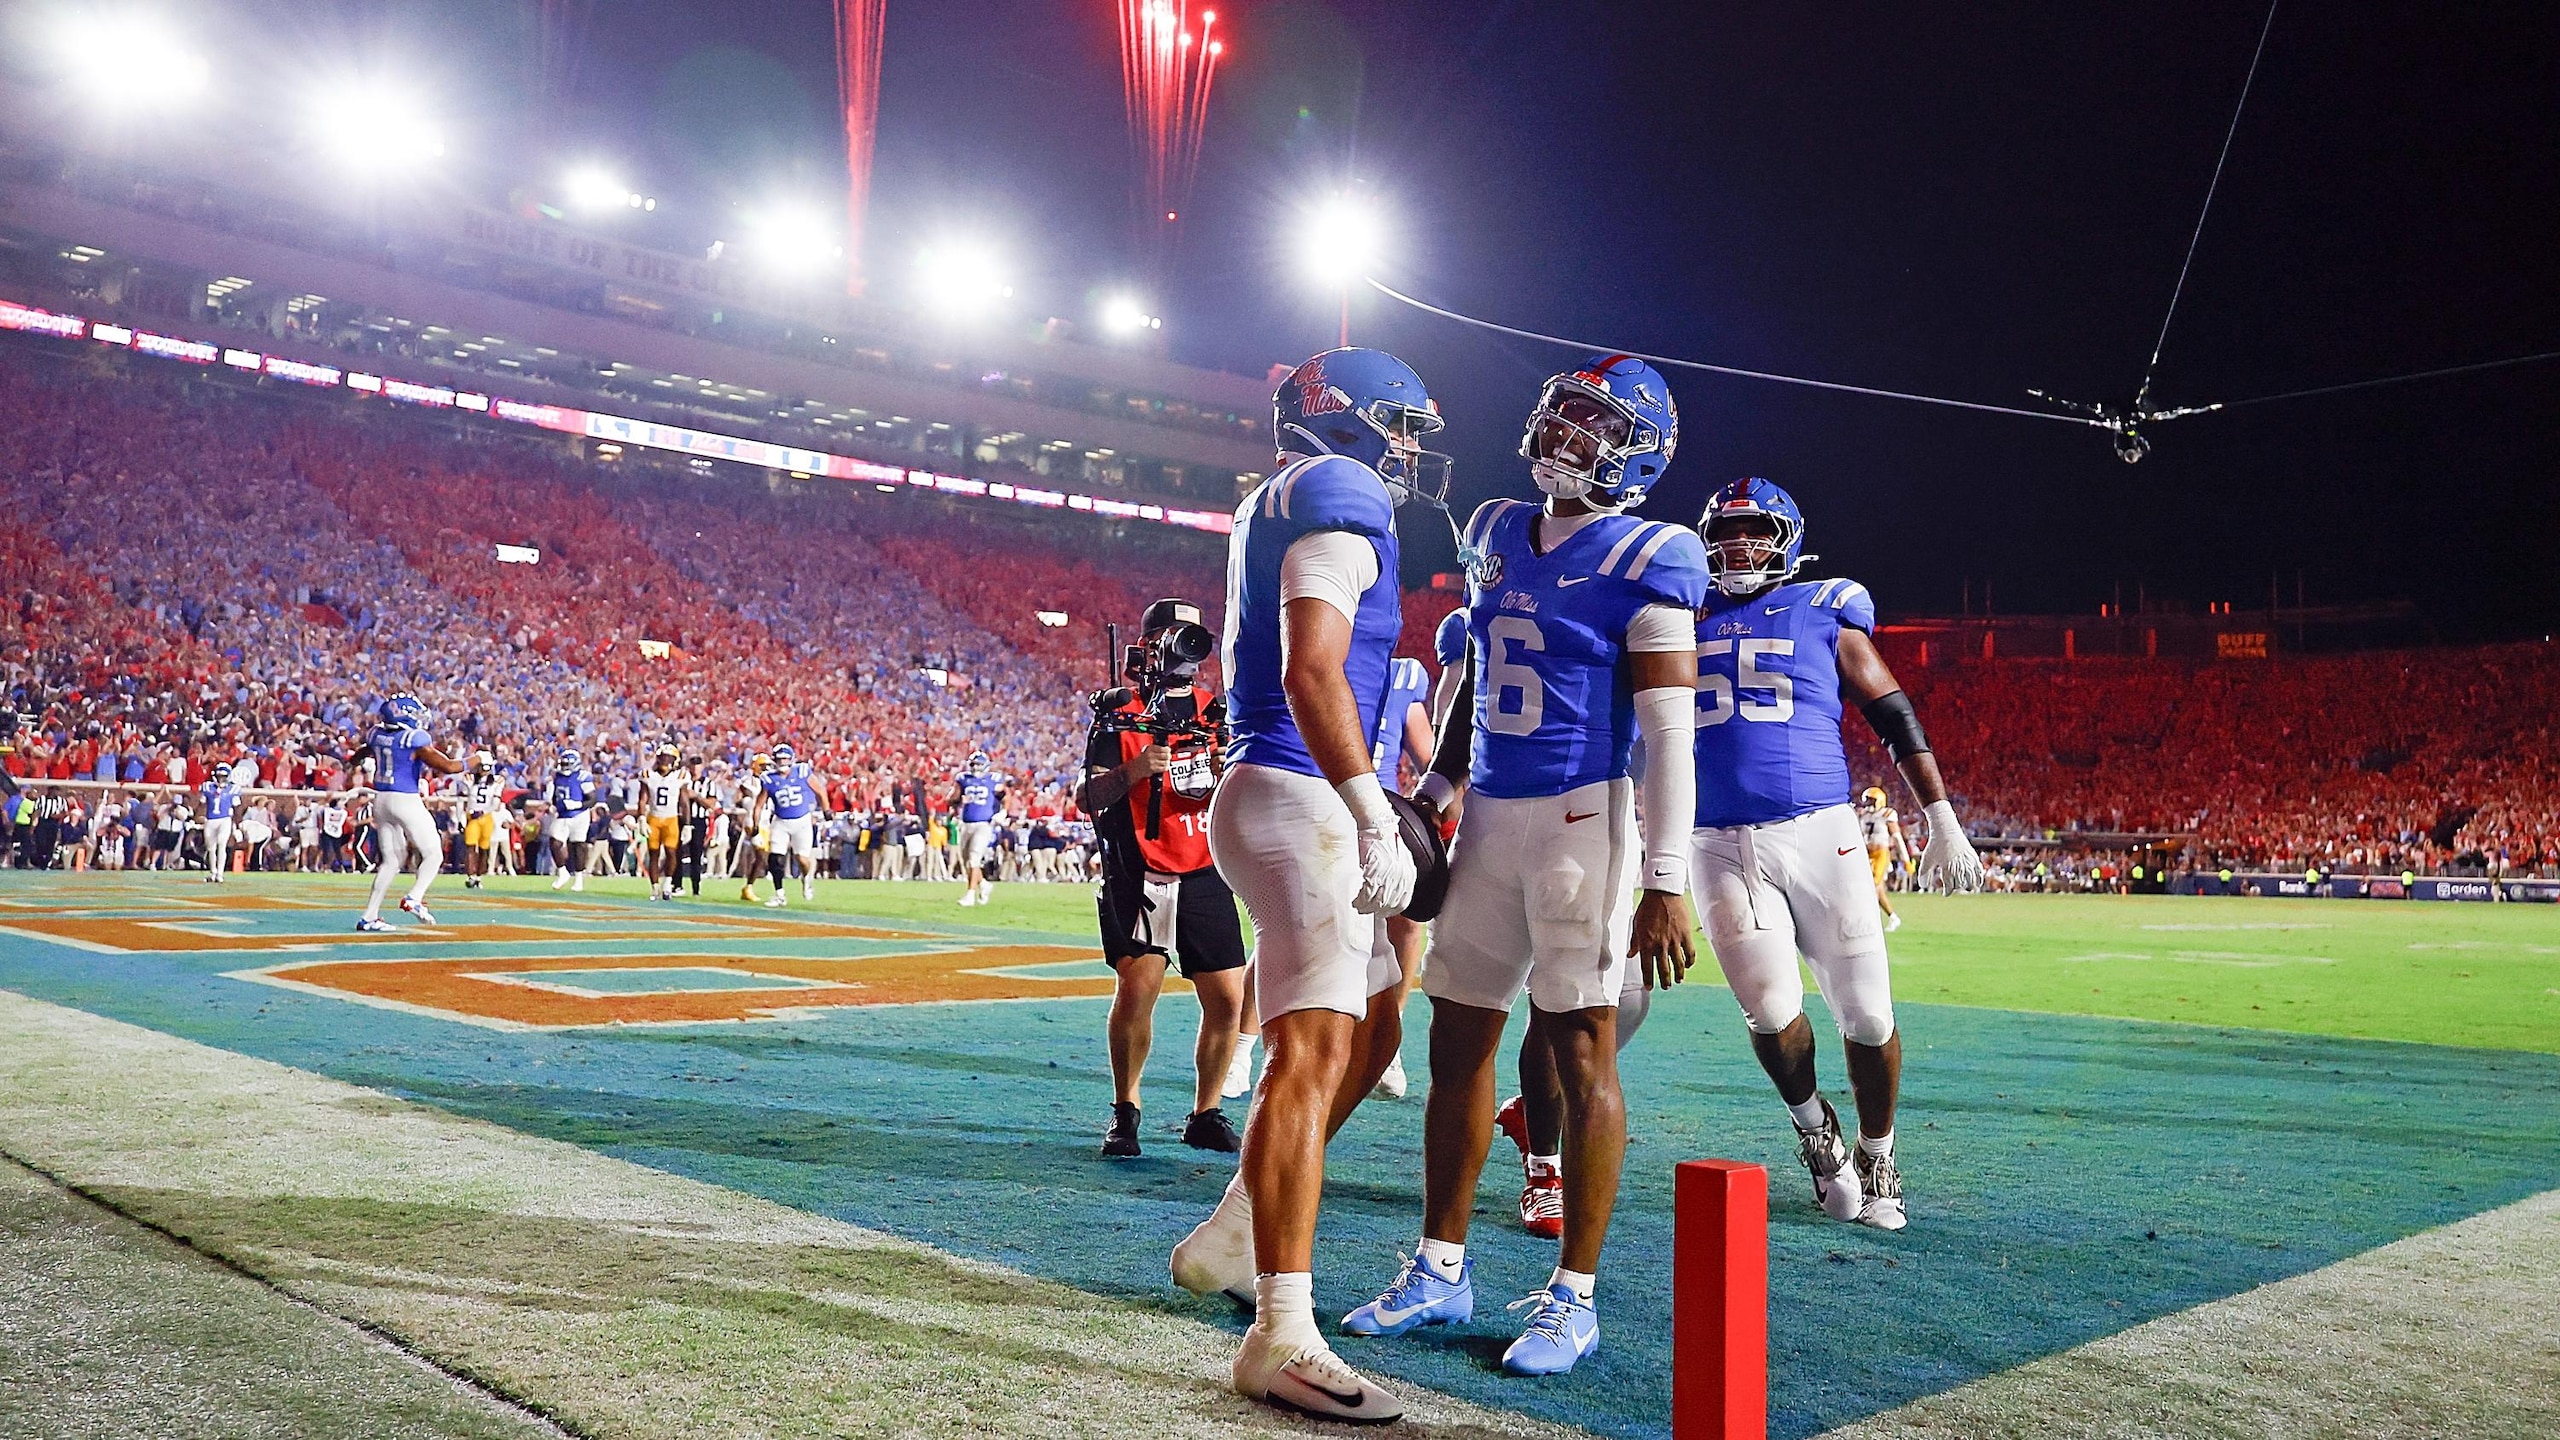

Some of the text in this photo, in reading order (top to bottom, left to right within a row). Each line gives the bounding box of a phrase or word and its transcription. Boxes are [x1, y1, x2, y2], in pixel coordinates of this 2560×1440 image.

[1294, 359, 1327, 386] Ole
[1301, 382, 1347, 417] Miss
[1486, 615, 1545, 736] 6
[1696, 638, 1795, 729] 55
[212, 797, 221, 815] 1
[477, 786, 486, 803] 5
[656, 787, 669, 806] 6
[1179, 811, 1207, 836] 18
